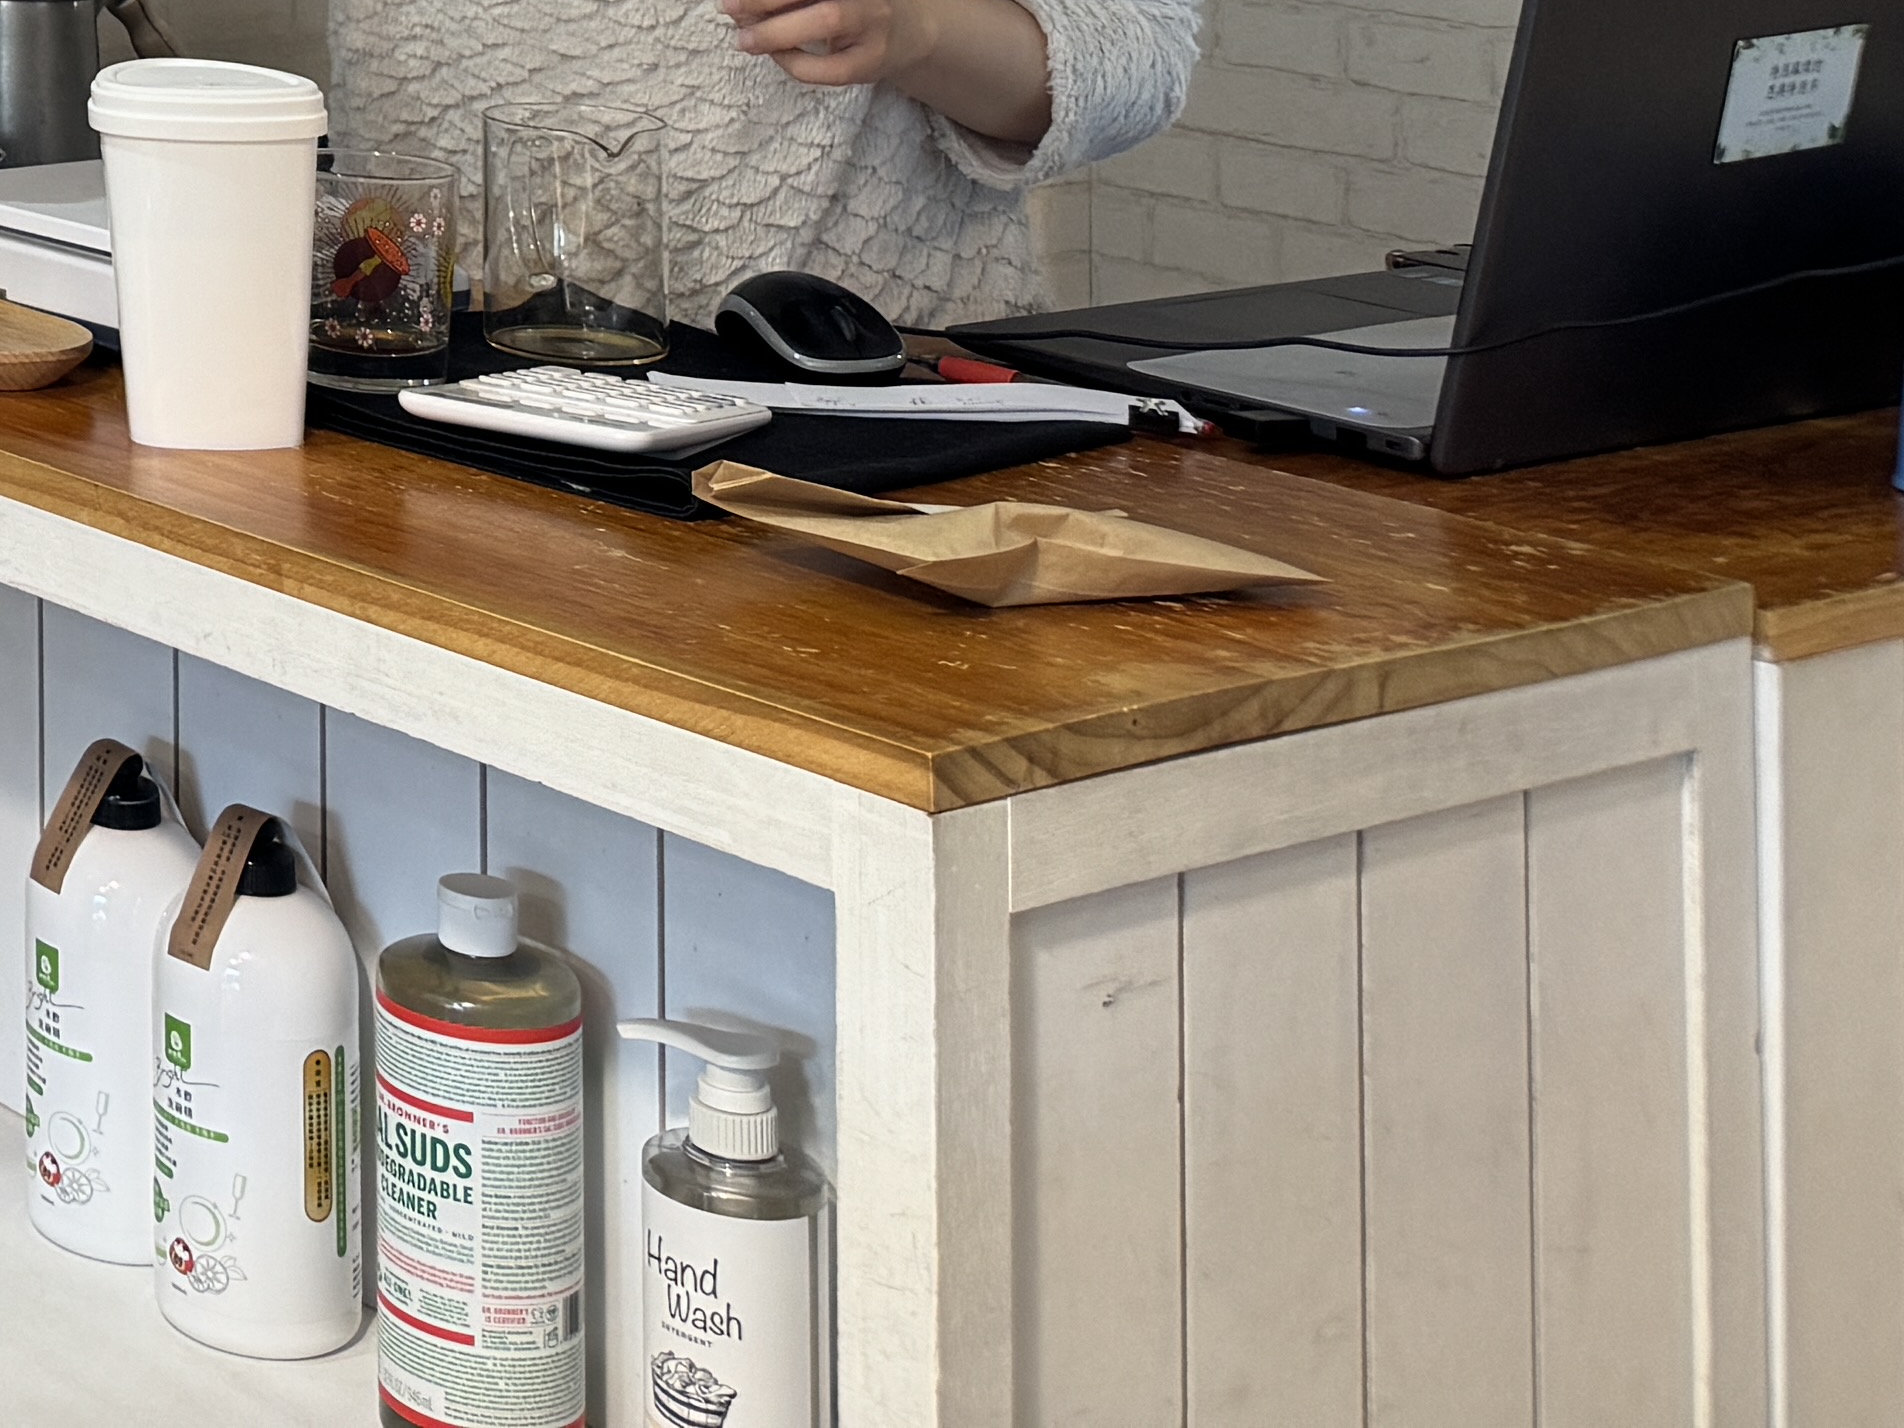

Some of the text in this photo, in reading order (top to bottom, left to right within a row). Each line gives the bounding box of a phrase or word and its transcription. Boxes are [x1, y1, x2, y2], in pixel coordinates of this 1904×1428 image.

[387, 1099, 450, 1135] BRONNER'S
[395, 1120, 473, 1179] SUDS
[380, 1173, 438, 1221] CLEANER
[451, 1229, 475, 1242] MILD
[647, 1228, 718, 1299] Hand
[661, 1321, 713, 1348] DETERGENT
[667, 1283, 743, 1341] Wash
